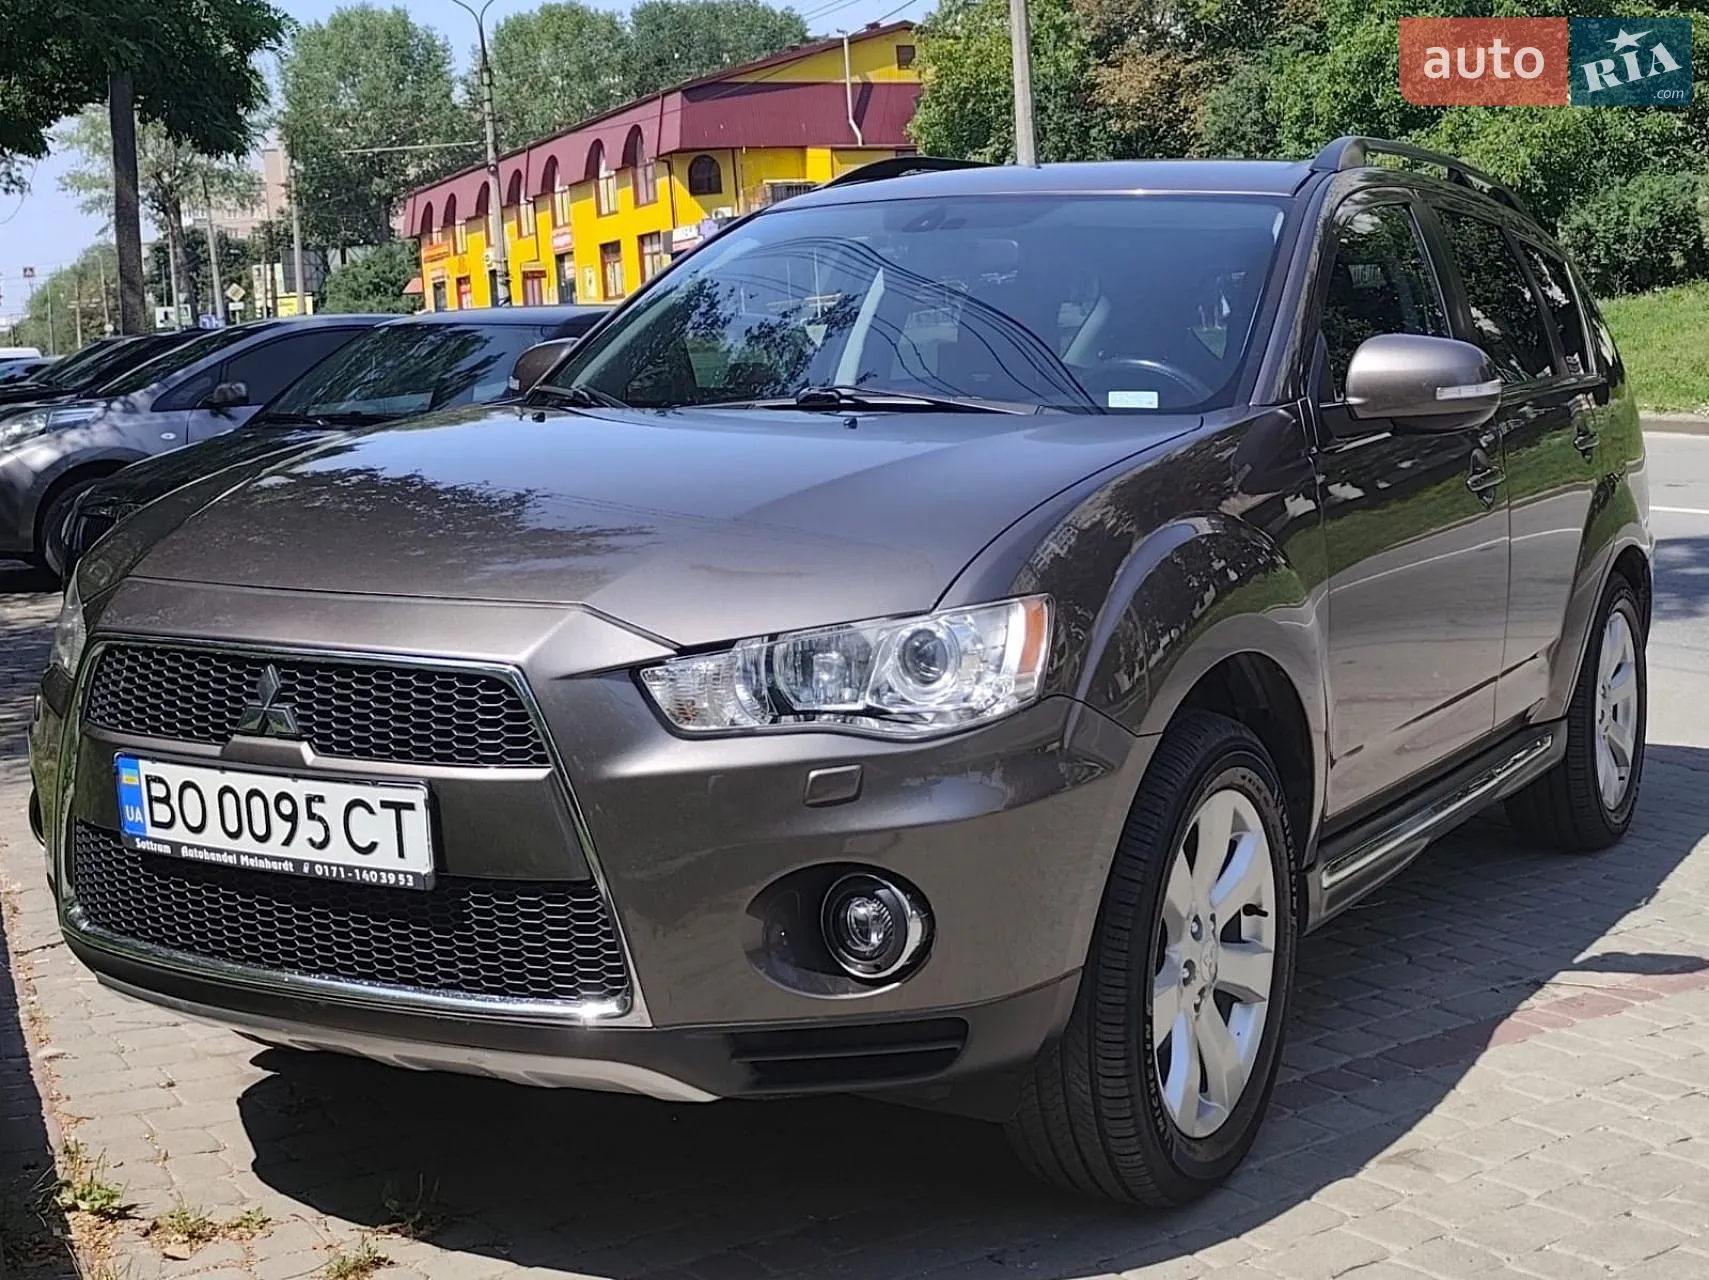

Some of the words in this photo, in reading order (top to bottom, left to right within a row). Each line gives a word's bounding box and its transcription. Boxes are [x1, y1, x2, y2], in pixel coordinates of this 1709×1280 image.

[125, 804, 144, 824] UA
[145, 773, 207, 834] BO
[217, 785, 331, 851] 0095
[342, 797, 416, 859] CT
[240, 853, 295, 872] Meinhardt
